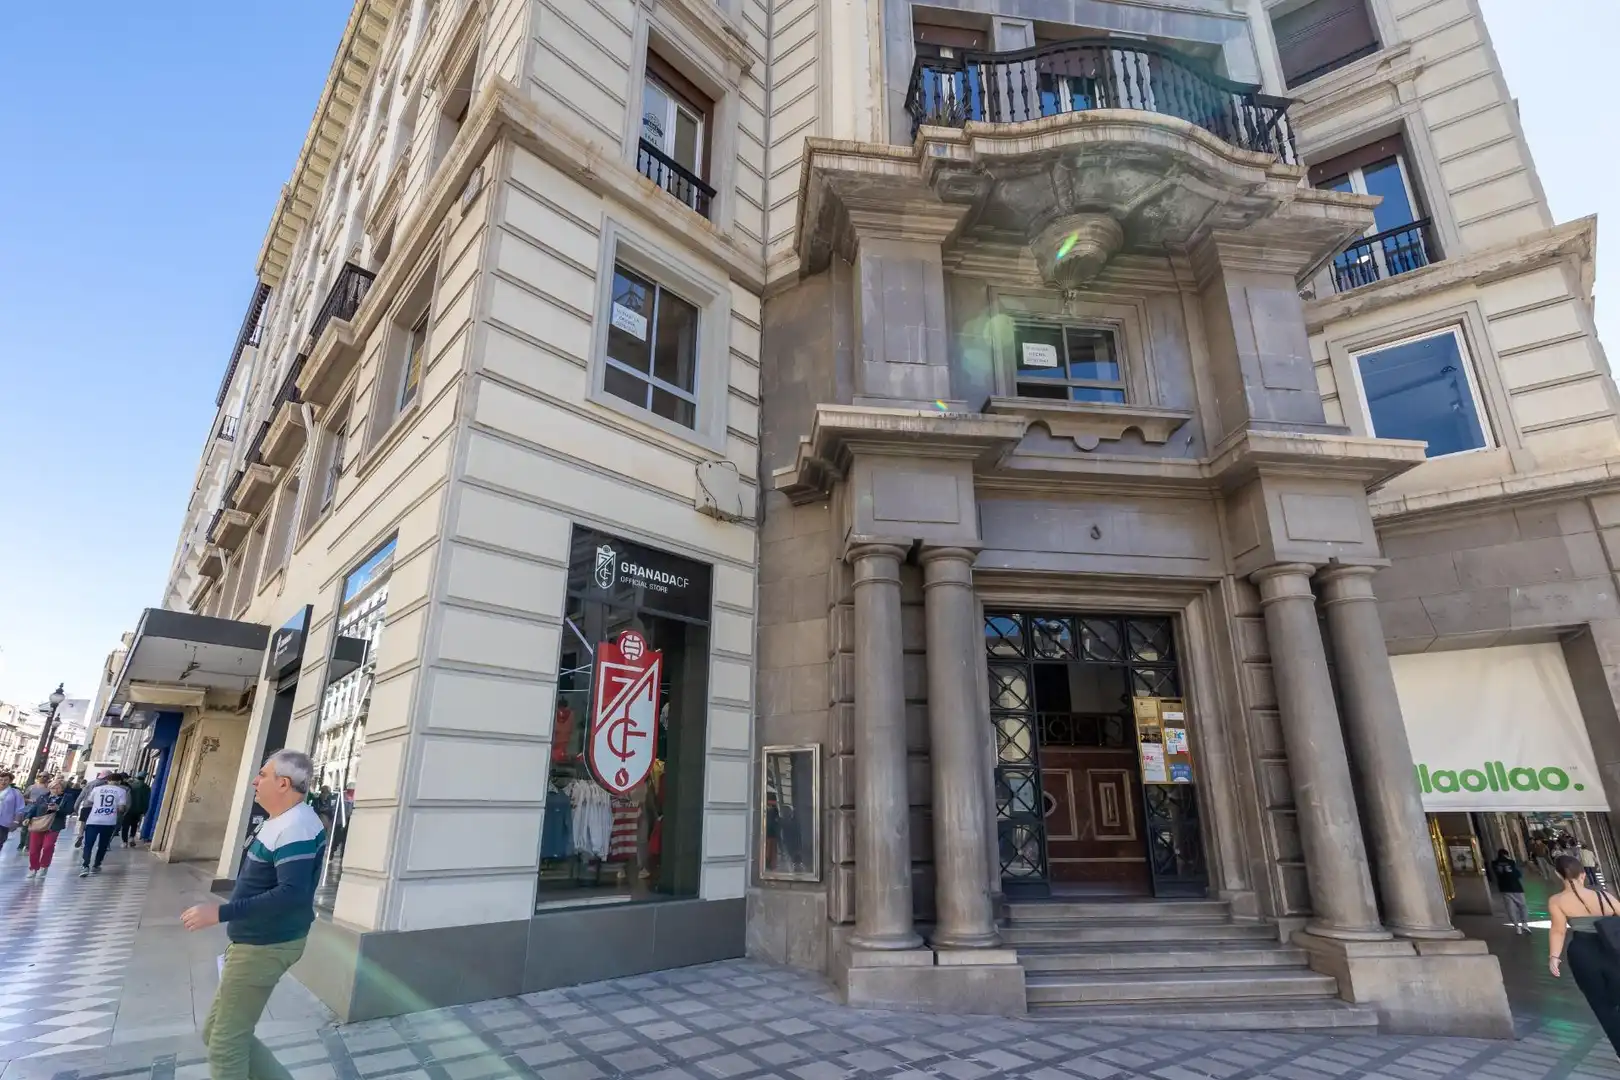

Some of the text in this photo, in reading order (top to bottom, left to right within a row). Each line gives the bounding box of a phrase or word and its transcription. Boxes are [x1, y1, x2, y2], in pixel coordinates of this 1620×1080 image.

[620, 576, 669, 594] OFFICIAL STORE
[100, 794, 115, 807] 19
